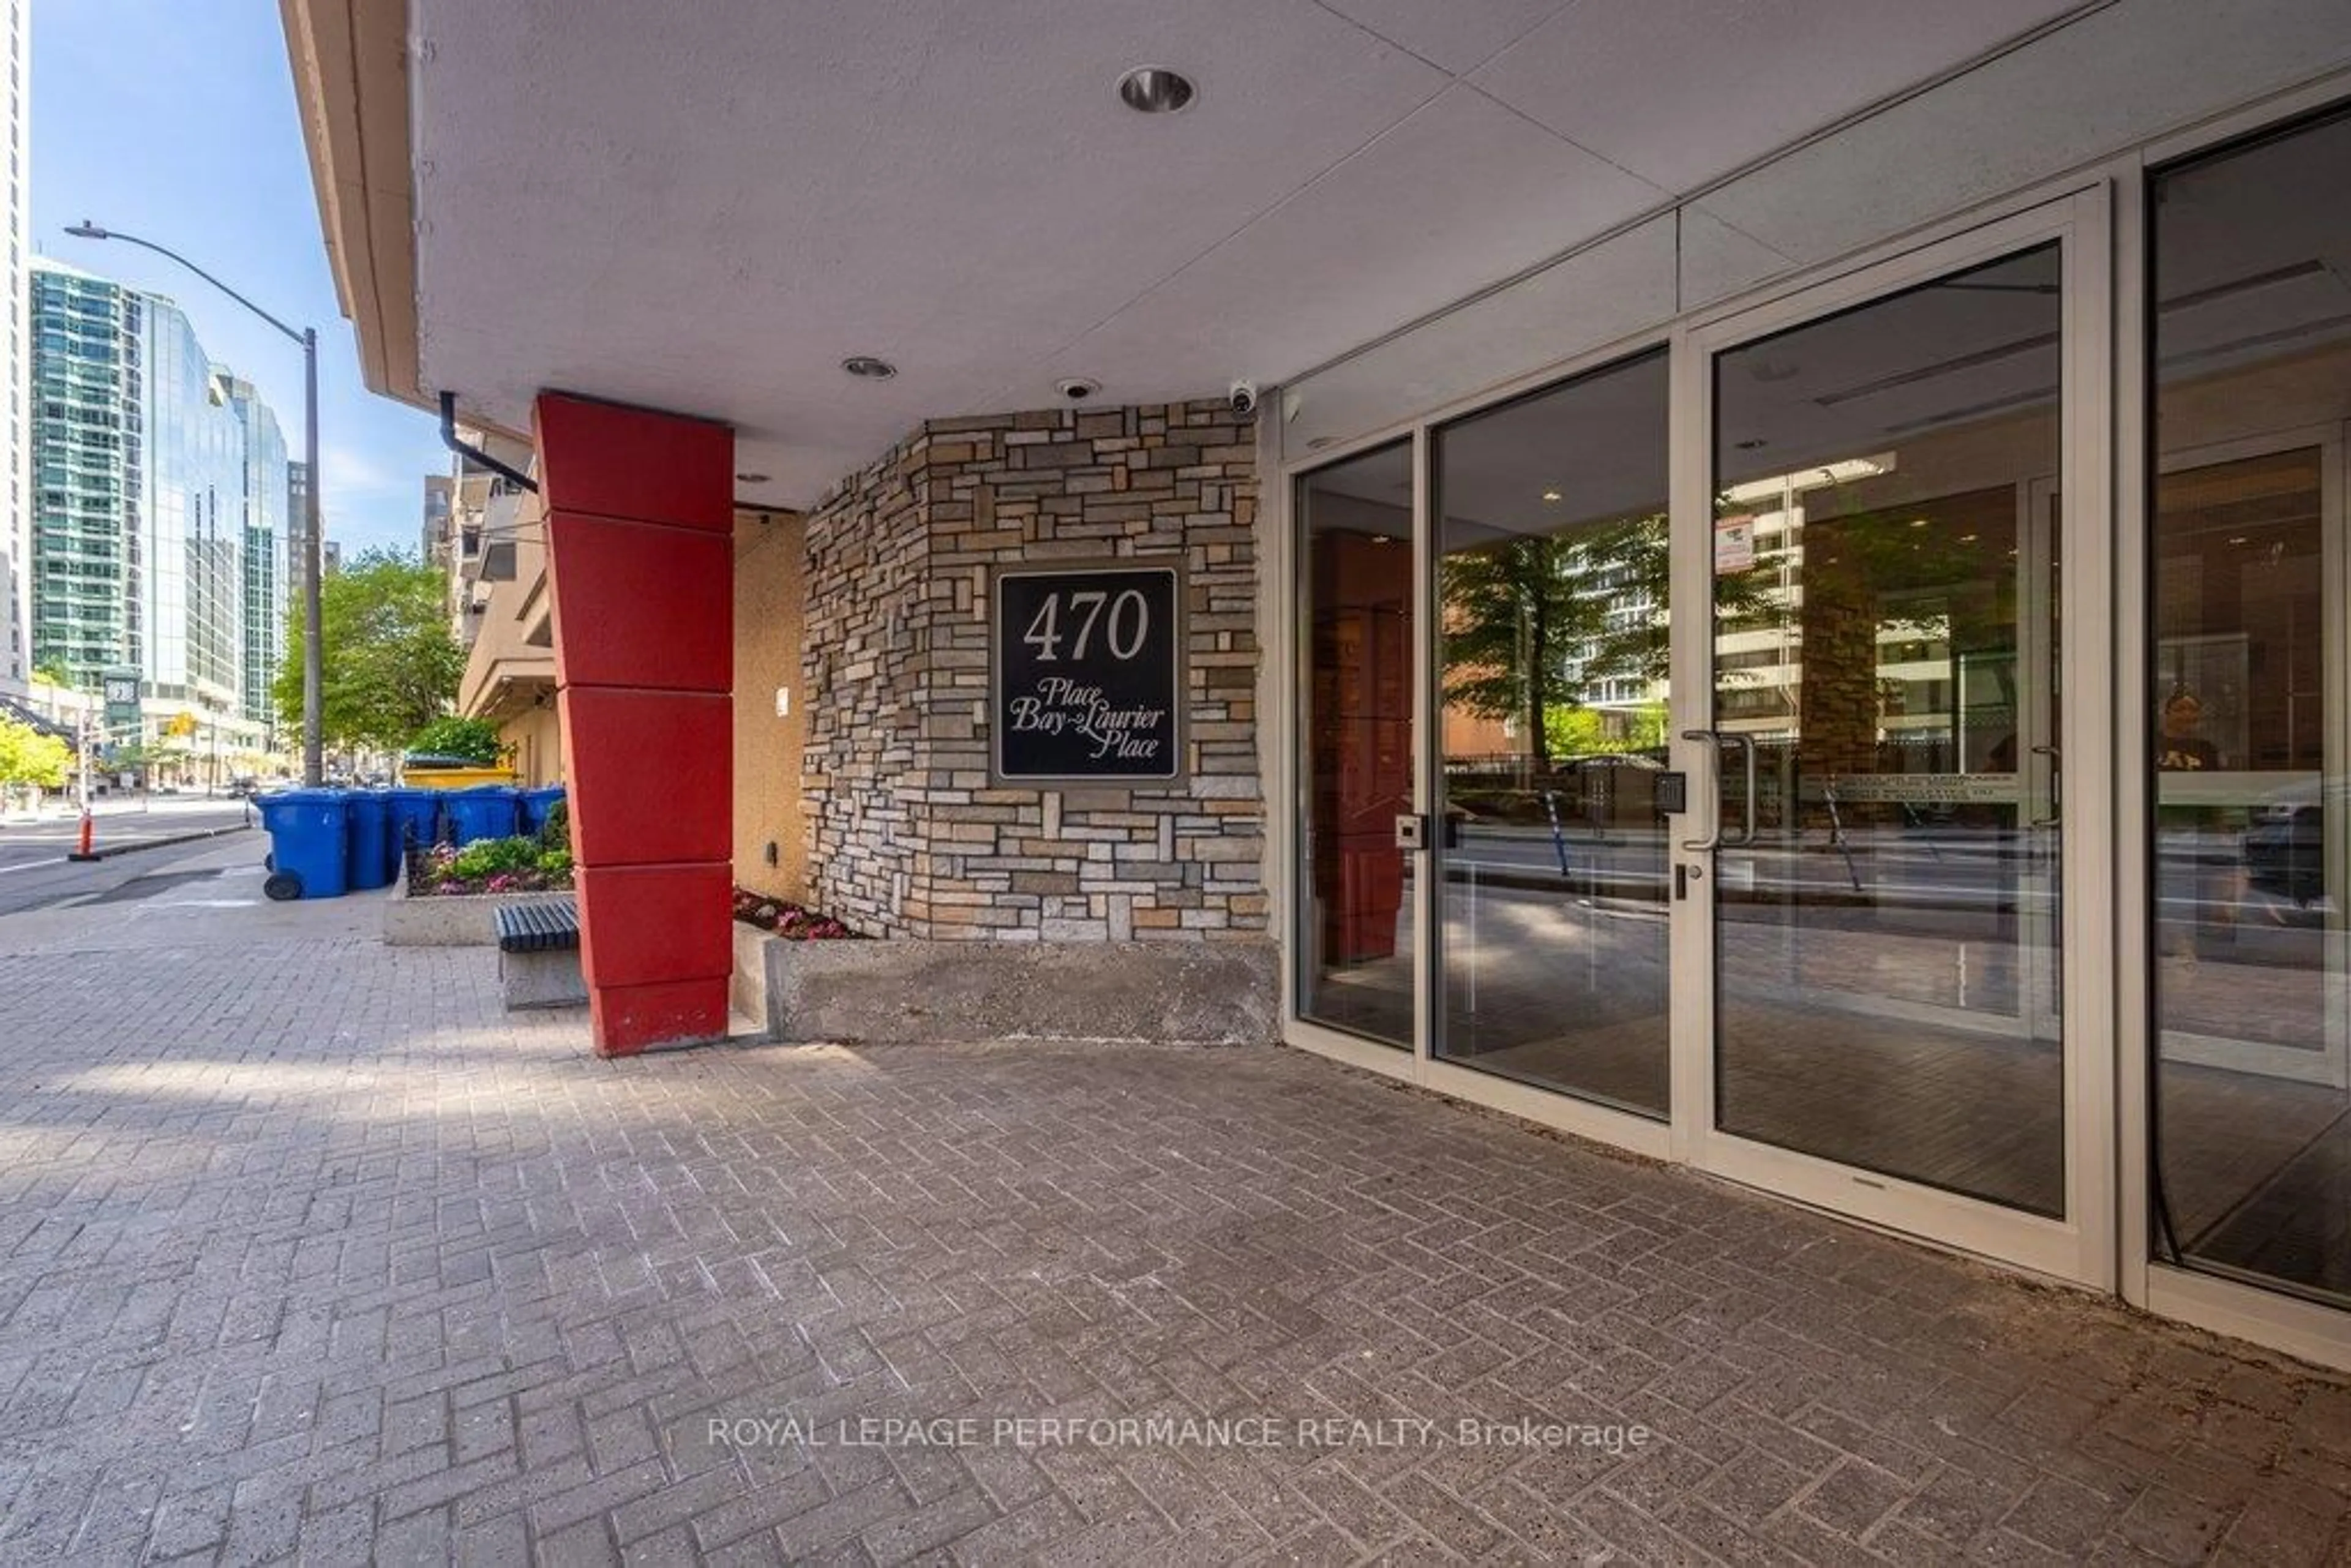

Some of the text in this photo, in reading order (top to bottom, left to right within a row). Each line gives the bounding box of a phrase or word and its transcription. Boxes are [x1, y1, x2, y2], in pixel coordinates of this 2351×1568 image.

[1024, 589, 1149, 661] 470
[1038, 677, 1103, 705] Place
[1090, 729, 1159, 759] Place
